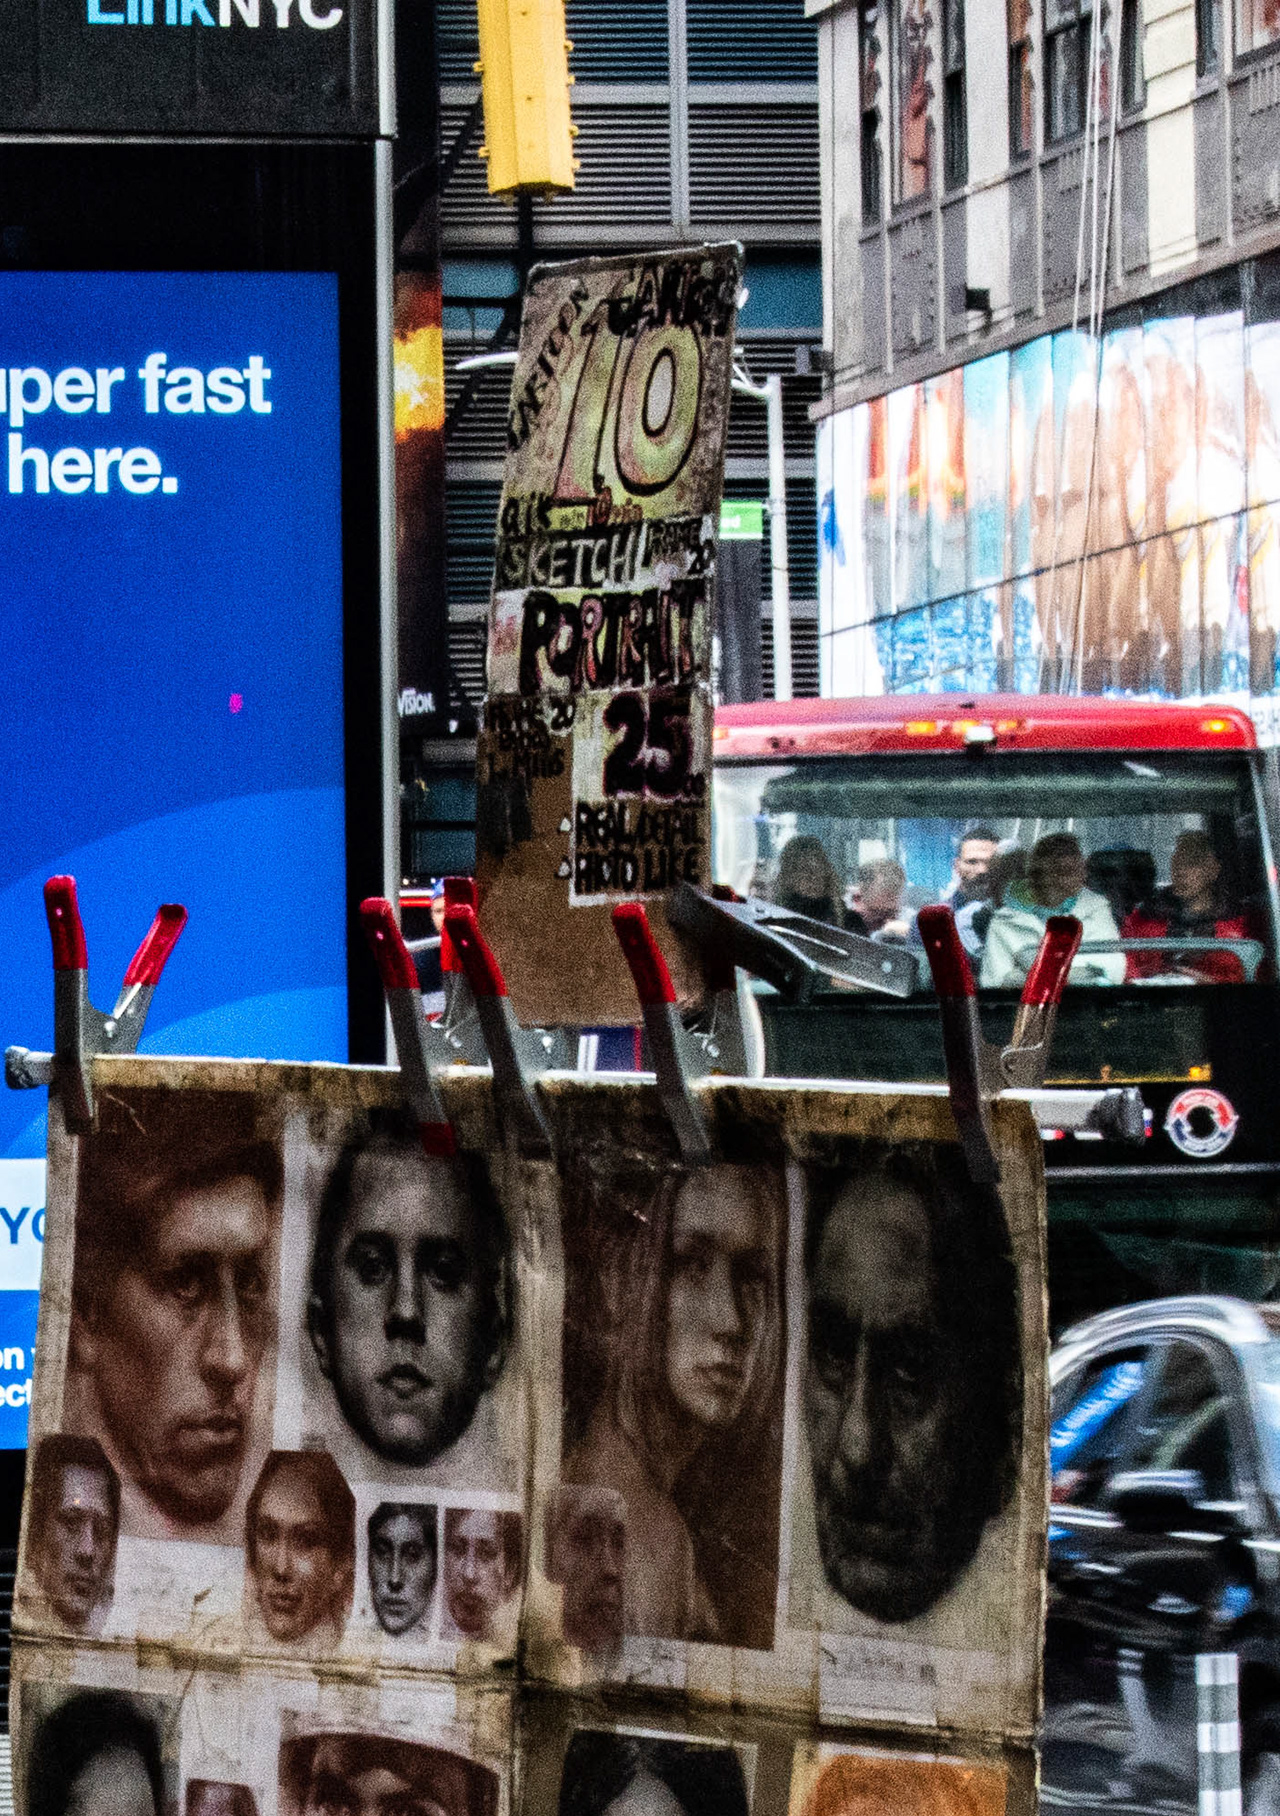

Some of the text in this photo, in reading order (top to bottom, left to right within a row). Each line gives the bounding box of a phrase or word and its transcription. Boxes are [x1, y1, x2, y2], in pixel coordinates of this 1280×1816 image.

[139, 352, 272, 414] fast
[552, 298, 704, 497] 10
[7, 433, 178, 494] here.
